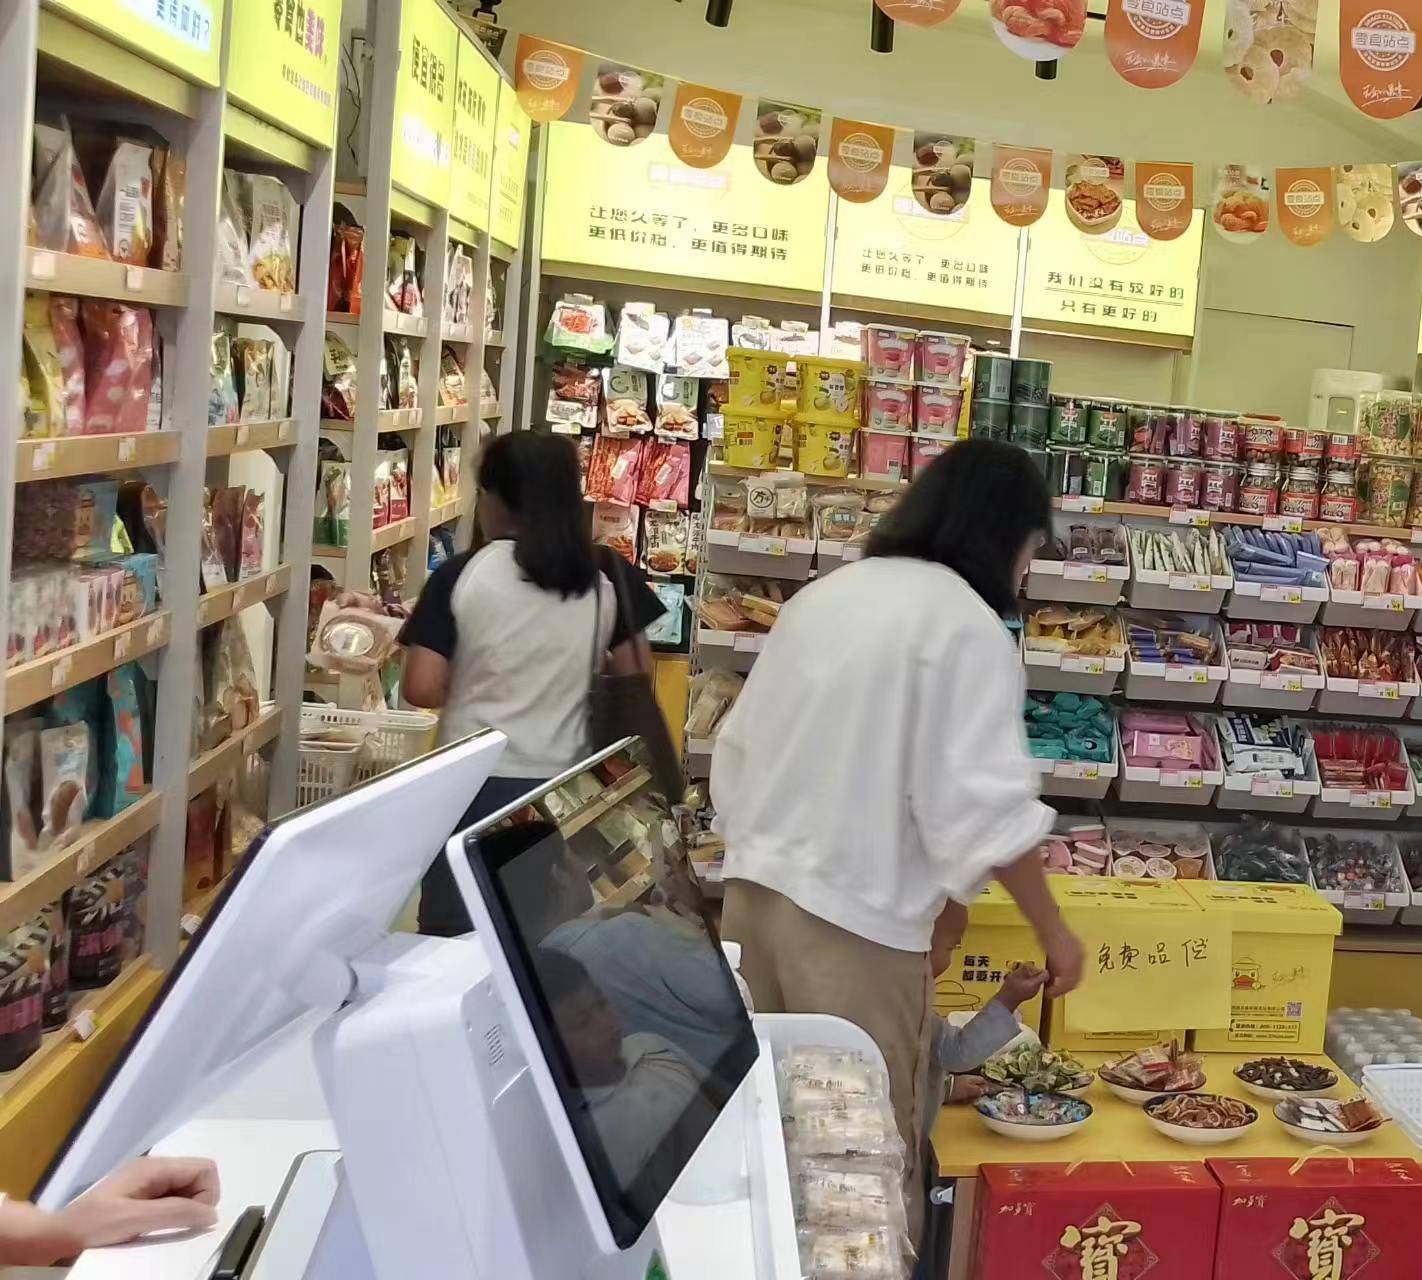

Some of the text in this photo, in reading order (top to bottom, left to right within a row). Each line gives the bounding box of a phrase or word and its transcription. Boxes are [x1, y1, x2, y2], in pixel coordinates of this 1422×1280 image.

[1355, 32, 1409, 49] 零食站点
[1048, 271, 1185, 300] 我们没有较好的
[1060, 300, 1157, 323] 只有更好的
[964, 955, 990, 968] 每天
[962, 970, 1007, 983] 都要开
